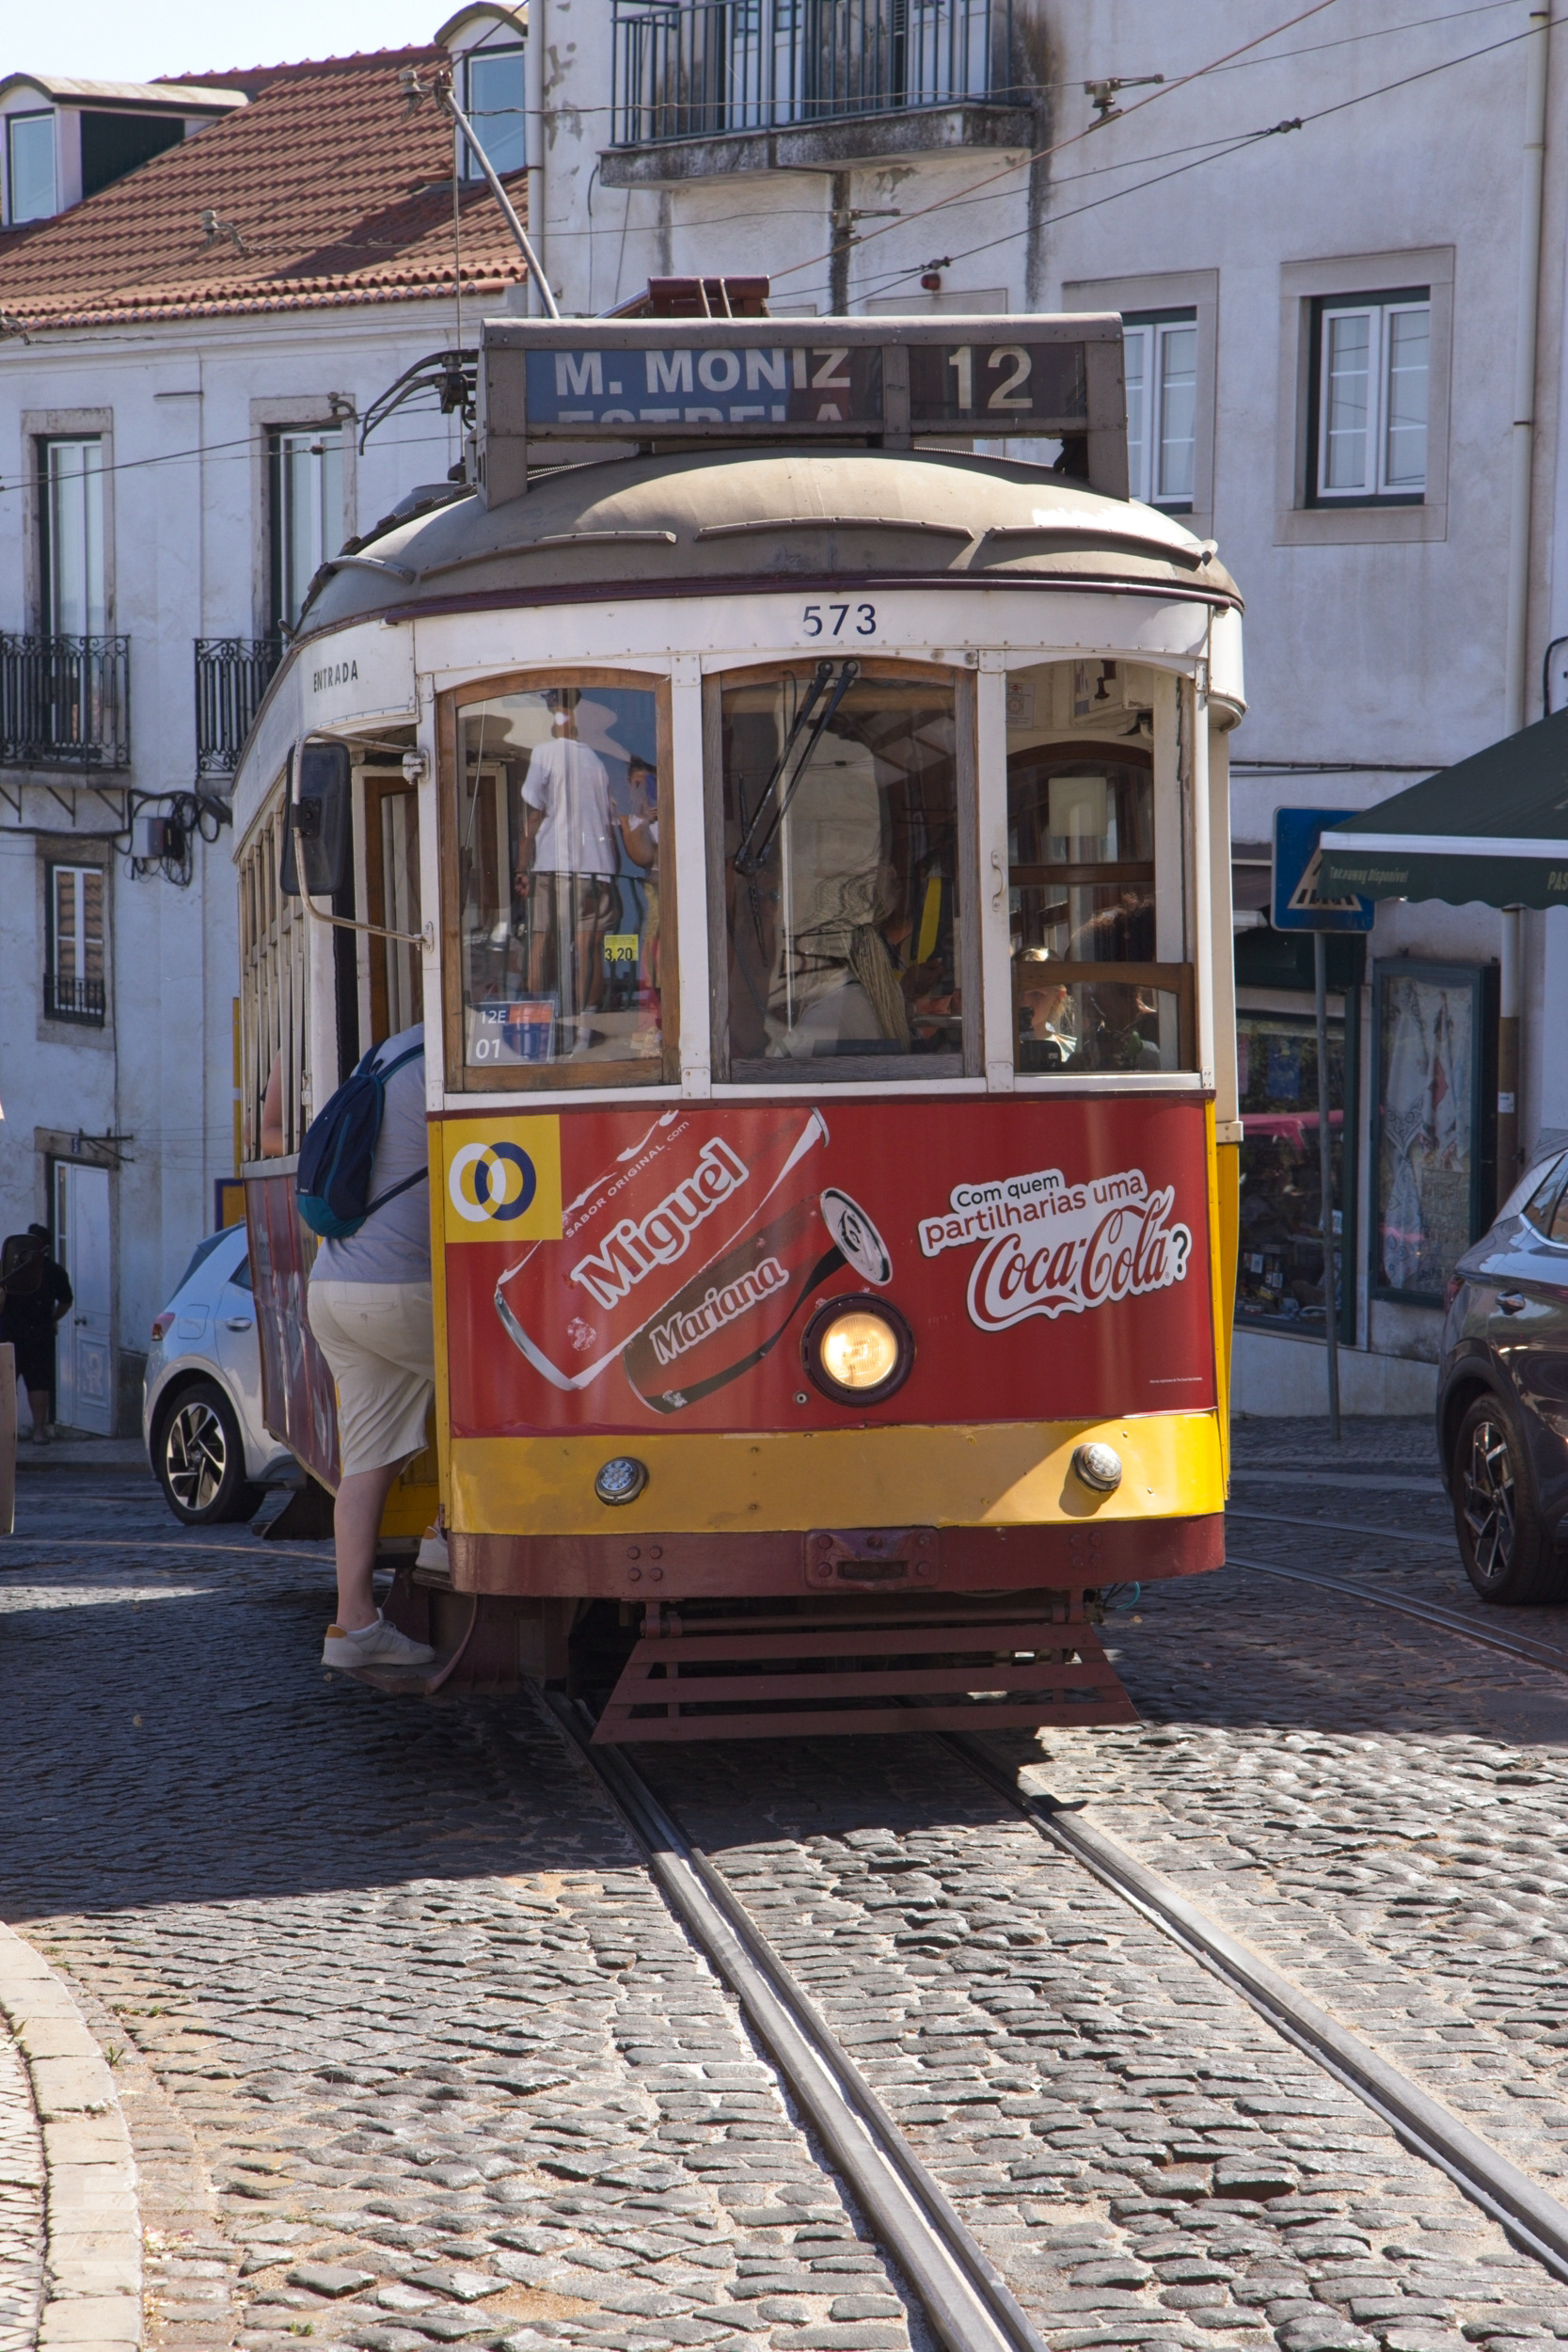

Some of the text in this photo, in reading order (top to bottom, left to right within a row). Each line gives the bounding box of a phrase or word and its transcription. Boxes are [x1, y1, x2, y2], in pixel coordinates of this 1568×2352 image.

[555, 347, 851, 395] M. MONIZ
[948, 345, 1033, 409] 12
[802, 603, 877, 637] 573
[313, 660, 358, 693] ENTRADA
[480, 1009, 506, 1025] 12E
[475, 1039, 500, 1059] 01
[565, 1120, 690, 1238] SABOR ORIGINAL com
[957, 1175, 1060, 1208] Com quem
[571, 1137, 749, 1309] Miguel
[926, 1176, 1144, 1249] partilharias uma
[649, 1257, 790, 1364] Mariana
